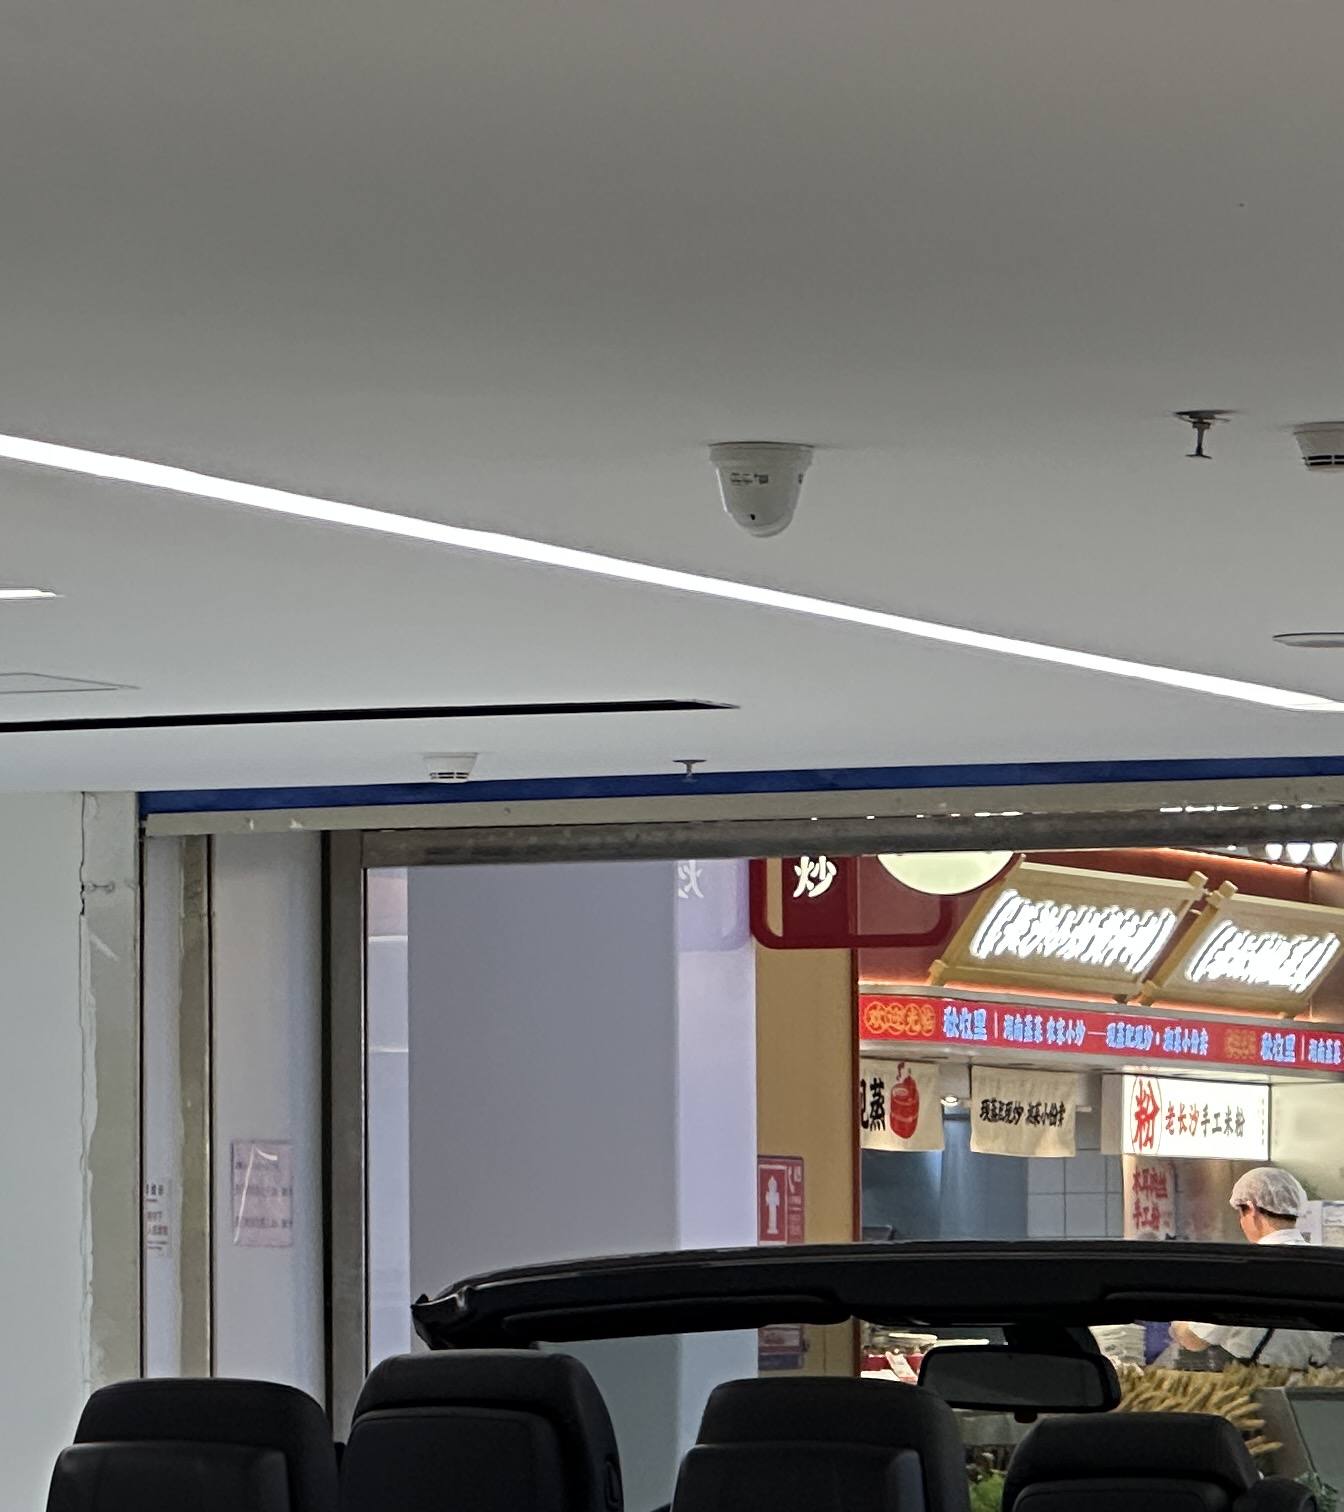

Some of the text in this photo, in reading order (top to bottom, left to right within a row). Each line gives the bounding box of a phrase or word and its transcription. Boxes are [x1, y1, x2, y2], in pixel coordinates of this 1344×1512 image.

[792, 855, 837, 898] 炒
[864, 1001, 936, 1036] 欢迎光临
[1133, 1079, 1160, 1151] 粉
[1164, 1100, 1246, 1138] 老长沙手工米粉
